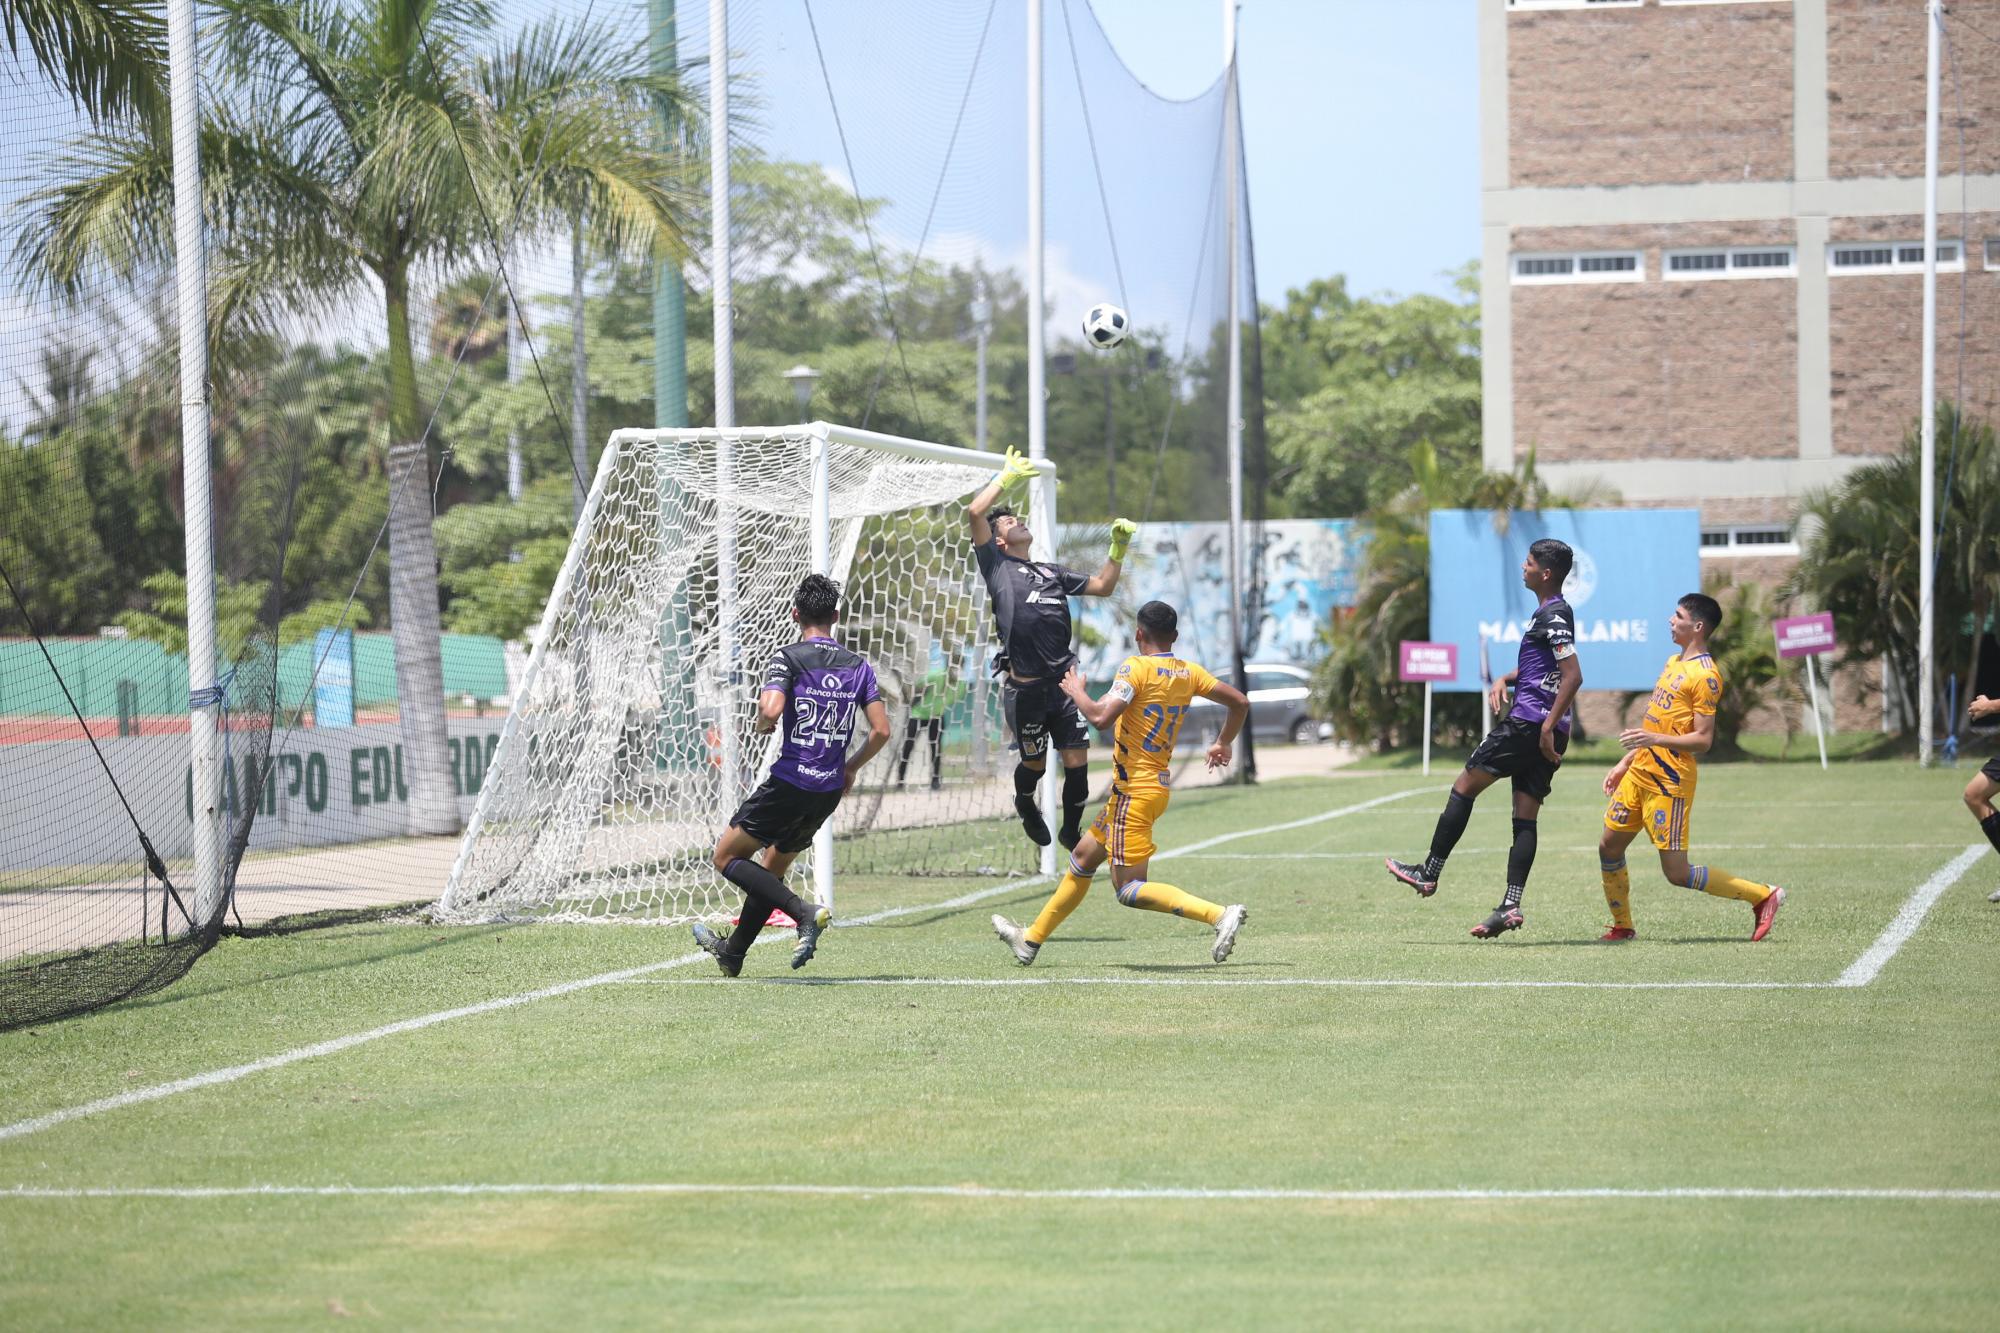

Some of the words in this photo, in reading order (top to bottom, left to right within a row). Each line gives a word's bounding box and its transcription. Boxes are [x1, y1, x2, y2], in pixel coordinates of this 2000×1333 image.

[805, 686, 832, 698] Banco
[790, 697, 856, 749] 244
[185, 751, 328, 824] AMPO
